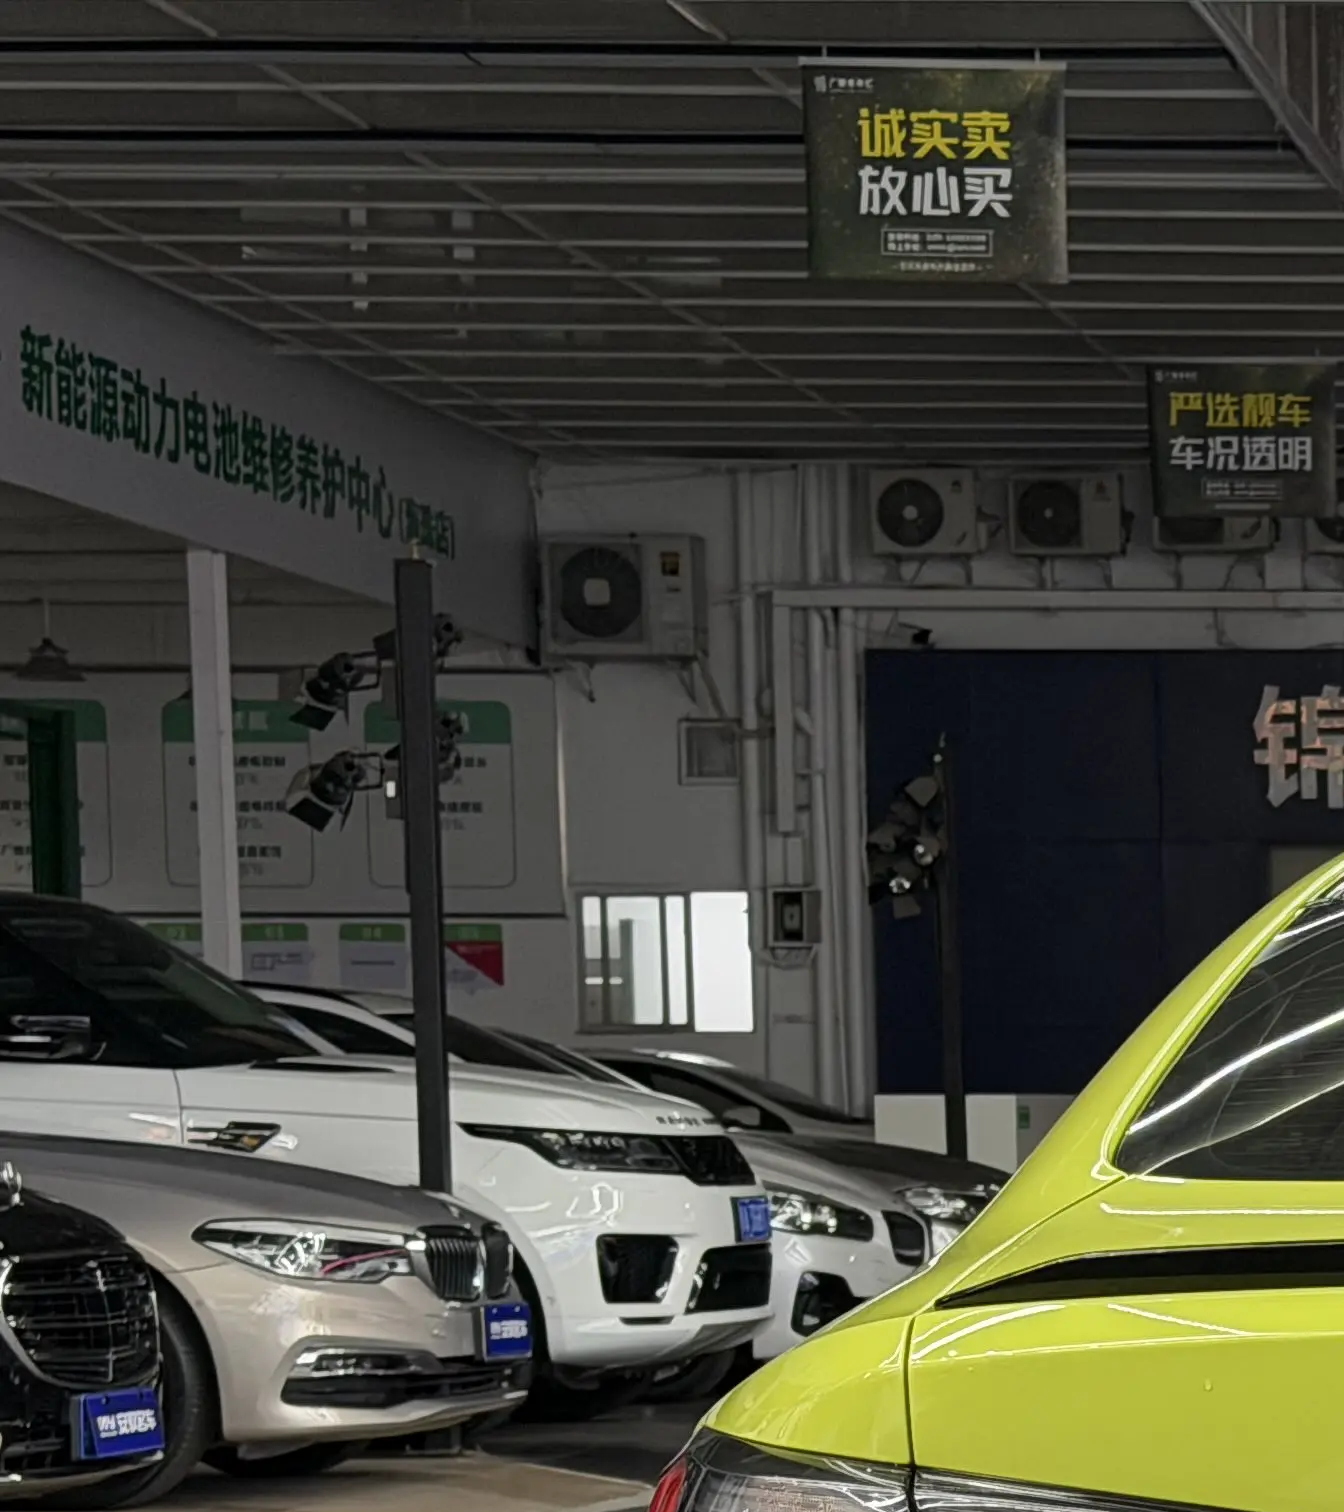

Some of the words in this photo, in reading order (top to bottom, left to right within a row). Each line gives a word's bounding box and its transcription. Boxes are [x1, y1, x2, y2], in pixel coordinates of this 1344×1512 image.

[857, 107, 1011, 160] 诚实卖
[857, 165, 1013, 218] 放心买
[1169, 391, 1312, 428] 严选靓车
[1169, 435, 1313, 471] 车况透明
